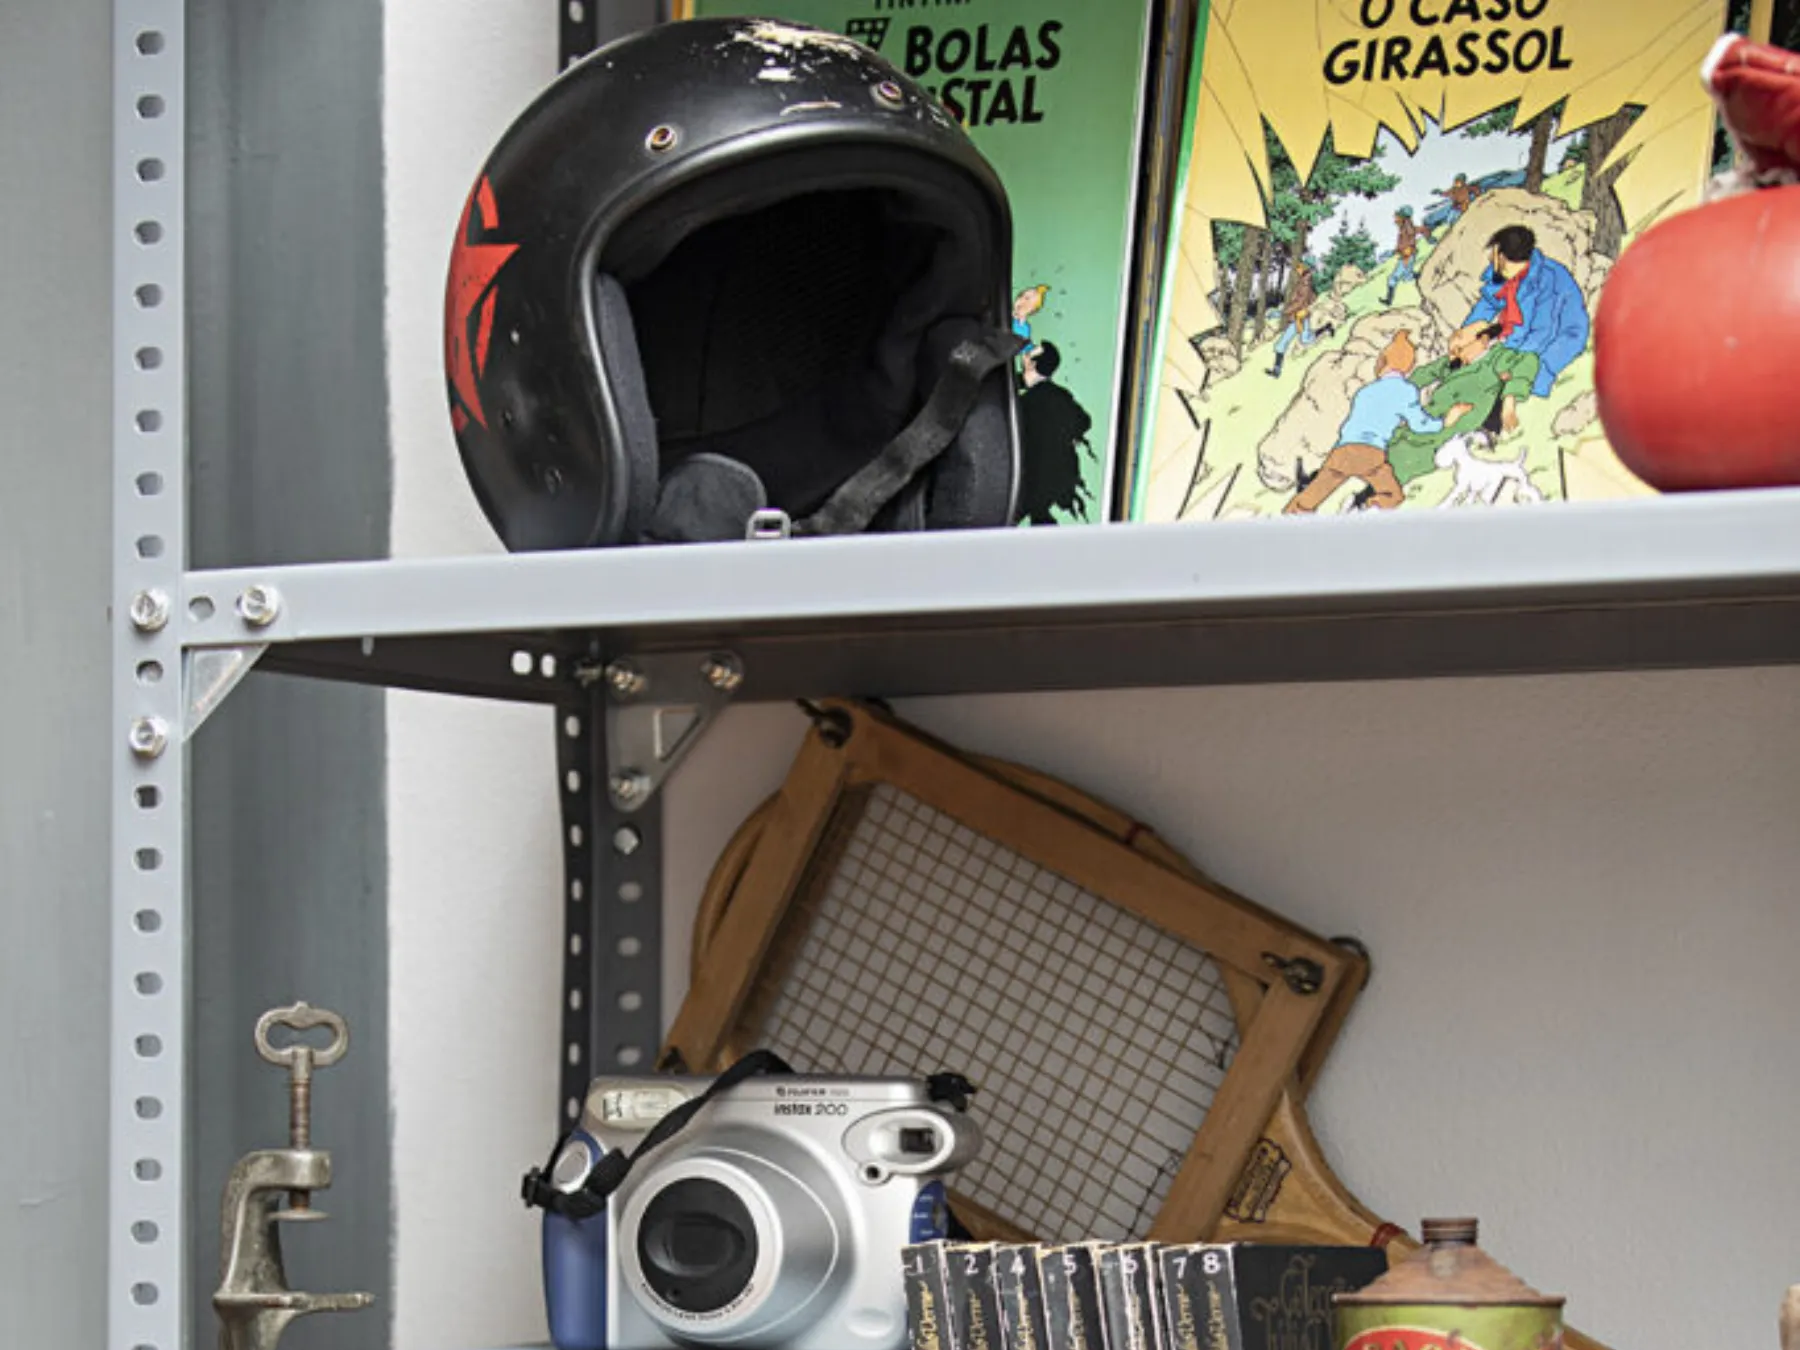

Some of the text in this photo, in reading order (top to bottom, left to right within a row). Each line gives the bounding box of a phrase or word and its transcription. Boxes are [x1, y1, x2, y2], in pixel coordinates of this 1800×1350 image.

[1360, 0, 1396, 28] O
[905, 20, 1064, 77] BOLAS
[1323, 26, 1574, 85] GIRASSOL
[814, 1103, 849, 1116] 200
[963, 1253, 979, 1275] 2
[1008, 1253, 1026, 1276] 4
[1062, 1252, 1077, 1275] 5
[1172, 1255, 1189, 1278] 7
[1201, 1250, 1221, 1274] 8
